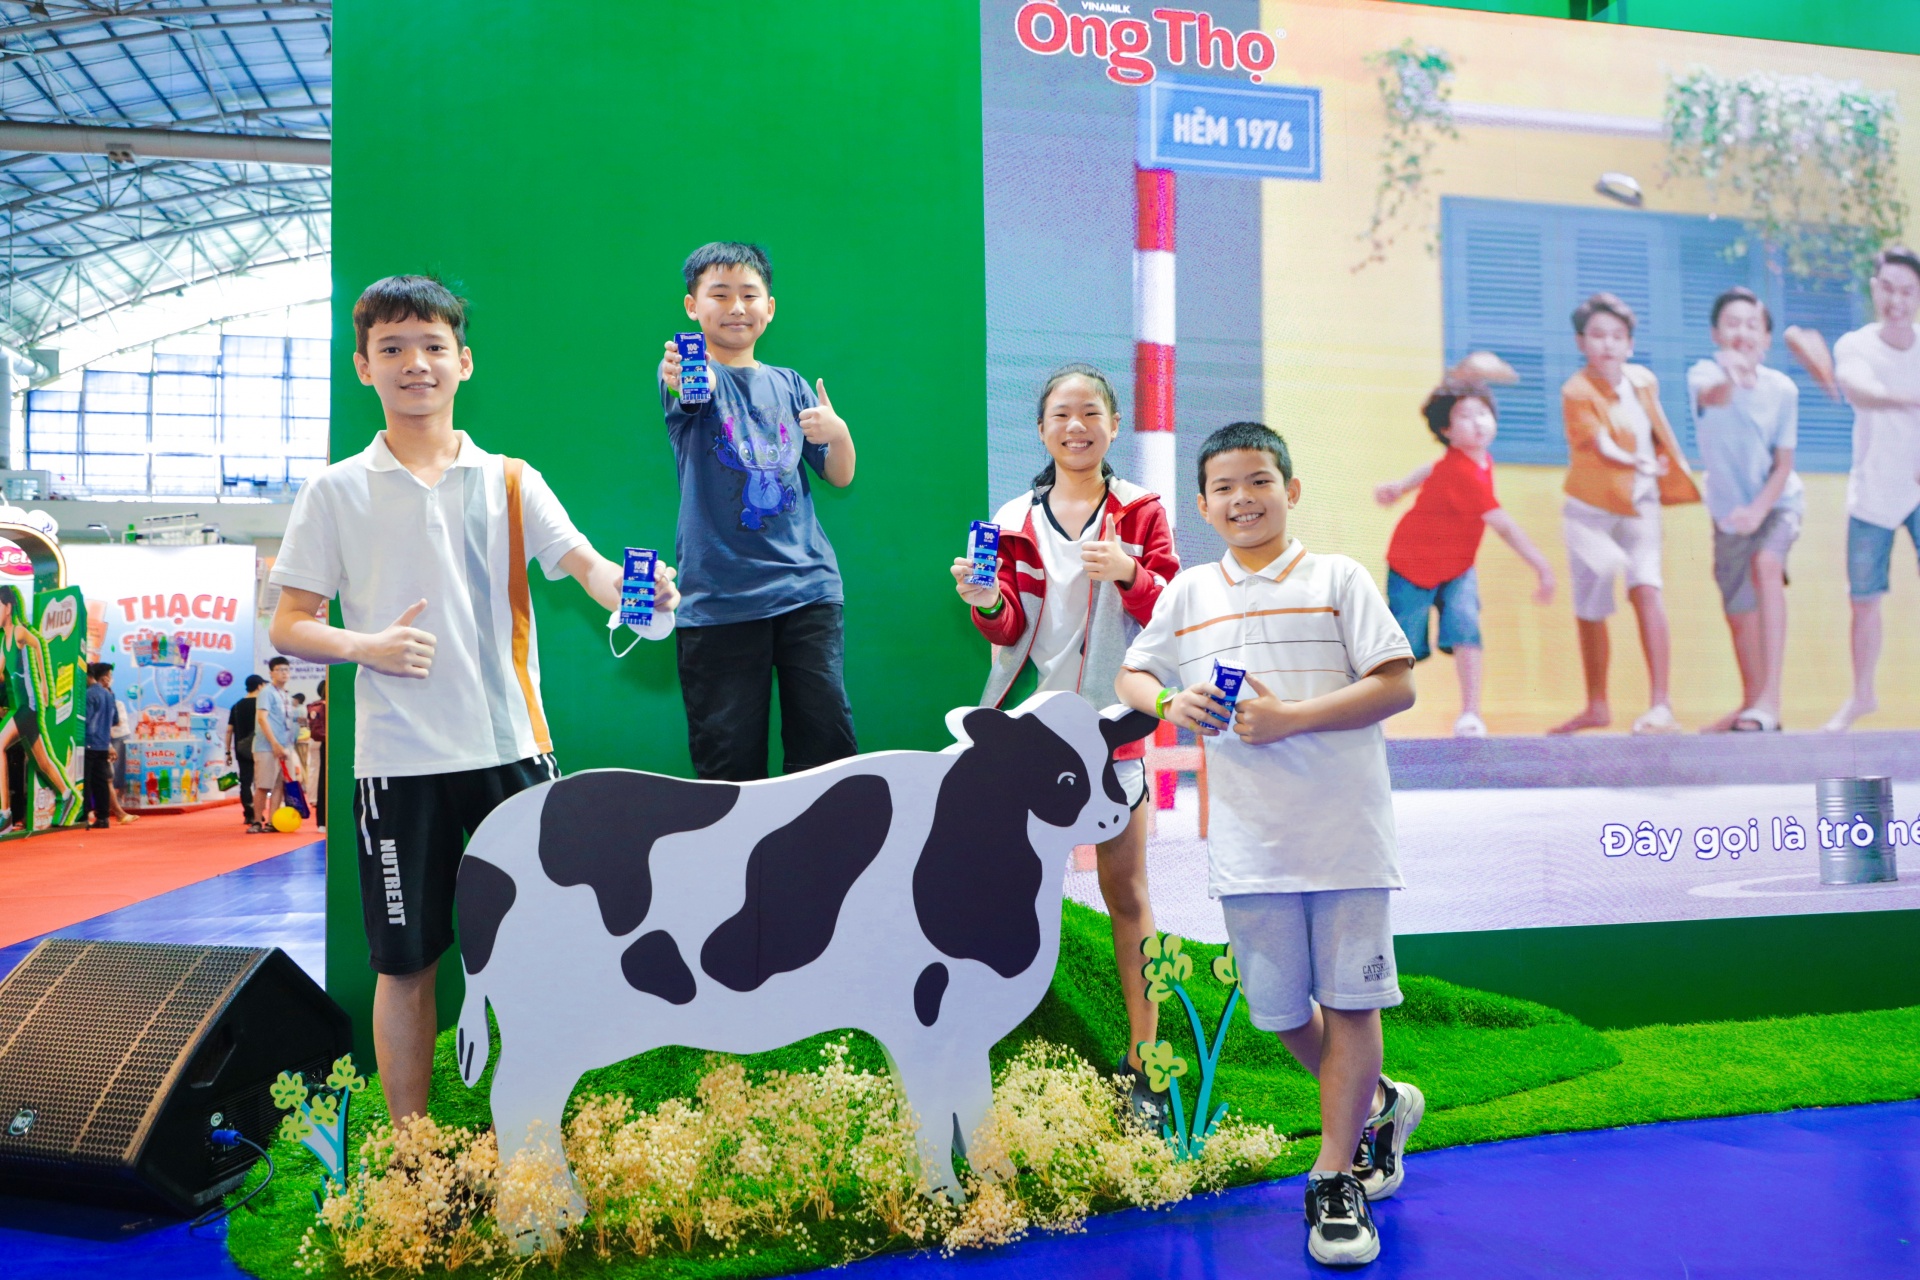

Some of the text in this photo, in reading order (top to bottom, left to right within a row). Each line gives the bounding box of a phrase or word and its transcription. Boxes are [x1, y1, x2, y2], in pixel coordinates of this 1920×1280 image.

[1081, 1, 1131, 14] VINAMILK
[1152, 8, 1277, 85] Thọ
[1235, 117, 1294, 152] 1976
[45, 608, 72, 631] MILO
[117, 593, 238, 625] THẠCH
[1600, 820, 1682, 862] Đây
[1694, 818, 1759, 860] gọi
[1772, 816, 1806, 850] là
[1817, 814, 1875, 849] trò
[379, 839, 407, 926] NUTRENT
